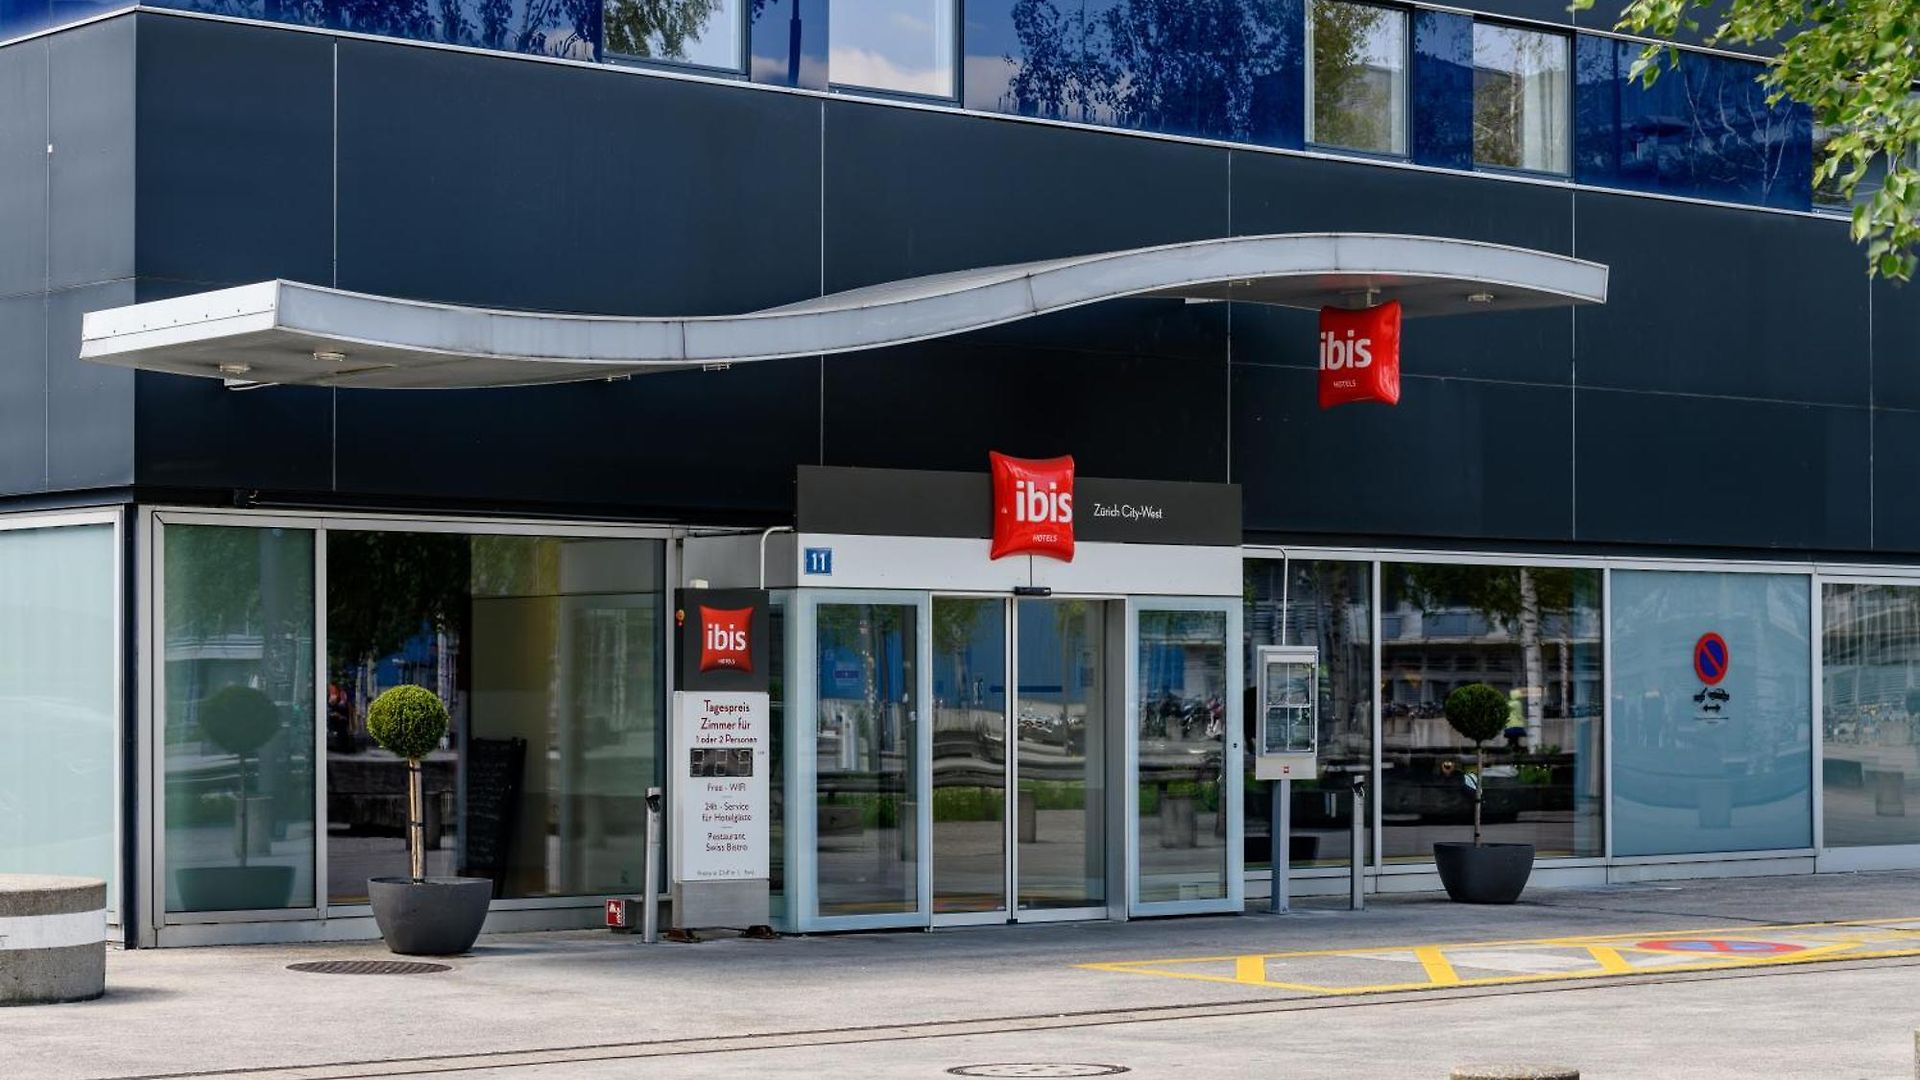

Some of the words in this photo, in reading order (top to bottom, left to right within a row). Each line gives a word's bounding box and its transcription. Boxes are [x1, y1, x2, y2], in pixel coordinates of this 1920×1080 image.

[1320, 330, 1372, 370] ibis
[1333, 380, 1357, 388] HOTELS
[1015, 481, 1072, 523] ibis
[1093, 503, 1120, 517] Zürich
[1121, 504, 1163, 521] City-West
[1032, 534, 1058, 543] HOTELS
[811, 553, 826, 571] 11
[707, 623, 746, 651] ibis
[704, 699, 750, 716] Tagespreis
[701, 717, 735, 730] Zimmer
[738, 717, 751, 730] für
[701, 734, 718, 743] oder
[719, 735, 724, 743] 2
[725, 734, 758, 743] Personen
[707, 783, 722, 792] Free
[724, 802, 749, 811] Service
[707, 832, 746, 841] Restaurant
[726, 843, 748, 852] Bistro
